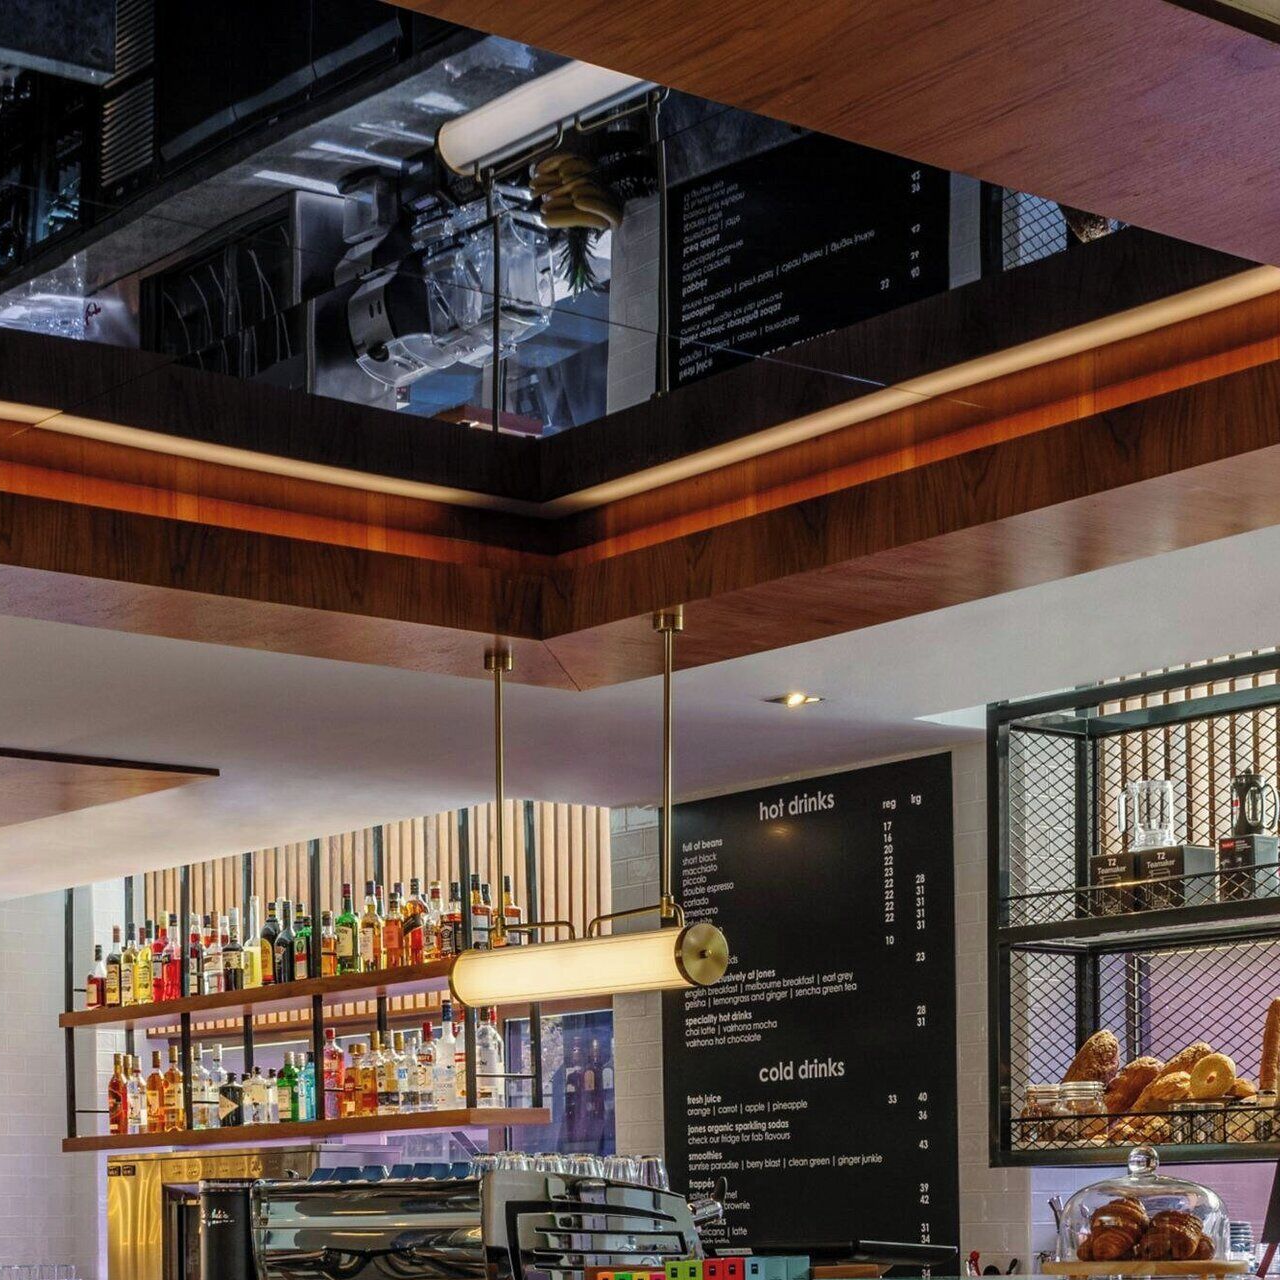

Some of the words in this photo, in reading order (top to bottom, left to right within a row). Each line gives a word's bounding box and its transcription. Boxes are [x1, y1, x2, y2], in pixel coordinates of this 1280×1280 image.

[759, 798, 784, 821] hot
[788, 791, 835, 816] drinks
[882, 799, 896, 810] reg
[883, 822, 892, 831] 17
[682, 842, 692, 852] full
[701, 839, 723, 849] beans
[682, 856, 697, 866] short
[699, 852, 717, 862] black
[884, 856, 893, 866] 22
[682, 864, 718, 876] macchiato
[682, 875, 707, 887] piccolo
[683, 886, 706, 896] double
[706, 882, 734, 893] espresso
[683, 897, 709, 907] cortado
[684, 907, 719, 918] americano
[756, 969, 776, 981] jones
[708, 984, 738, 996] breakfast
[745, 980, 781, 992] melbourne
[783, 975, 815, 987] breakfast
[822, 972, 836, 983] earl
[837, 972, 853, 983] grey
[751, 992, 765, 1001] and
[766, 990, 788, 1002] ginger
[795, 986, 821, 997] sencha
[822, 984, 843, 996] green
[845, 982, 857, 991] tea
[719, 1012, 730, 1022] hot
[731, 1010, 752, 1021] drinks
[917, 1017, 926, 1027] 31
[753, 1020, 778, 1030] mocha
[715, 1036, 726, 1045] hot
[727, 1033, 762, 1044] chocolate
[759, 1061, 794, 1083] cold
[798, 1058, 845, 1081] drinks
[687, 1094, 703, 1105] fresh
[704, 1094, 722, 1105] juice
[888, 1094, 897, 1104] 33
[687, 1107, 711, 1118] orange
[718, 1104, 738, 1114] carrot
[745, 1102, 765, 1114] apple
[772, 1099, 808, 1112] pineapple
[687, 1124, 706, 1136] jones
[707, 1122, 734, 1134] organic
[735, 1120, 766, 1132] sparkling
[767, 1119, 789, 1129] sodas
[688, 1150, 723, 1161] smoothies
[688, 1162, 709, 1172] sunrise
[710, 1160, 739, 1172] paradise
[764, 1157, 781, 1168] blast
[788, 1156, 808, 1167] clean
[809, 1156, 830, 1168] green
[838, 1155, 860, 1166] ginger
[861, 1153, 883, 1165] junkie
